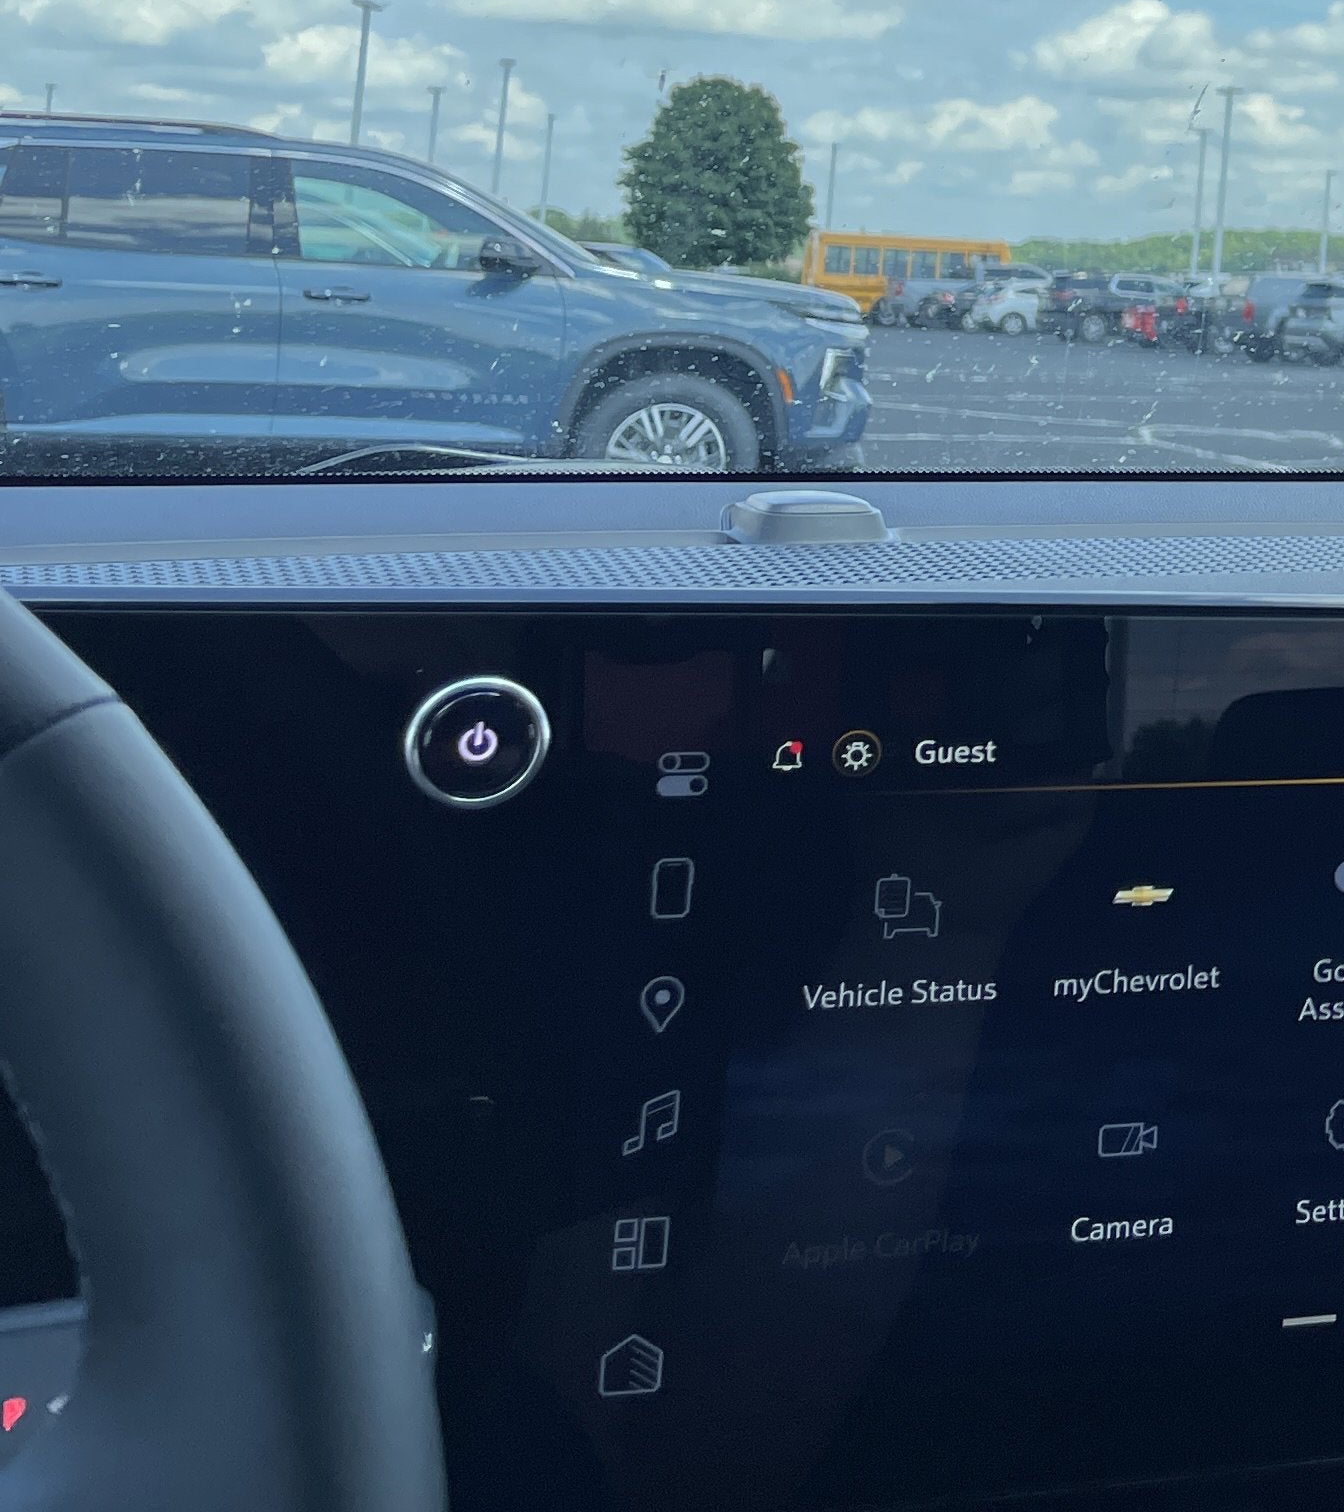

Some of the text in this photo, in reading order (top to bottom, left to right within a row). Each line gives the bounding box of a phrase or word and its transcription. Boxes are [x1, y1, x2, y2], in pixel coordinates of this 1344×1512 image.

[914, 739, 997, 765] Guest
[803, 978, 998, 1010] Vehicle Status
[1053, 964, 1221, 1003] myChevrolet
[1070, 1216, 1174, 1242] Camera
[782, 1228, 980, 1269] Apple CarPlay
